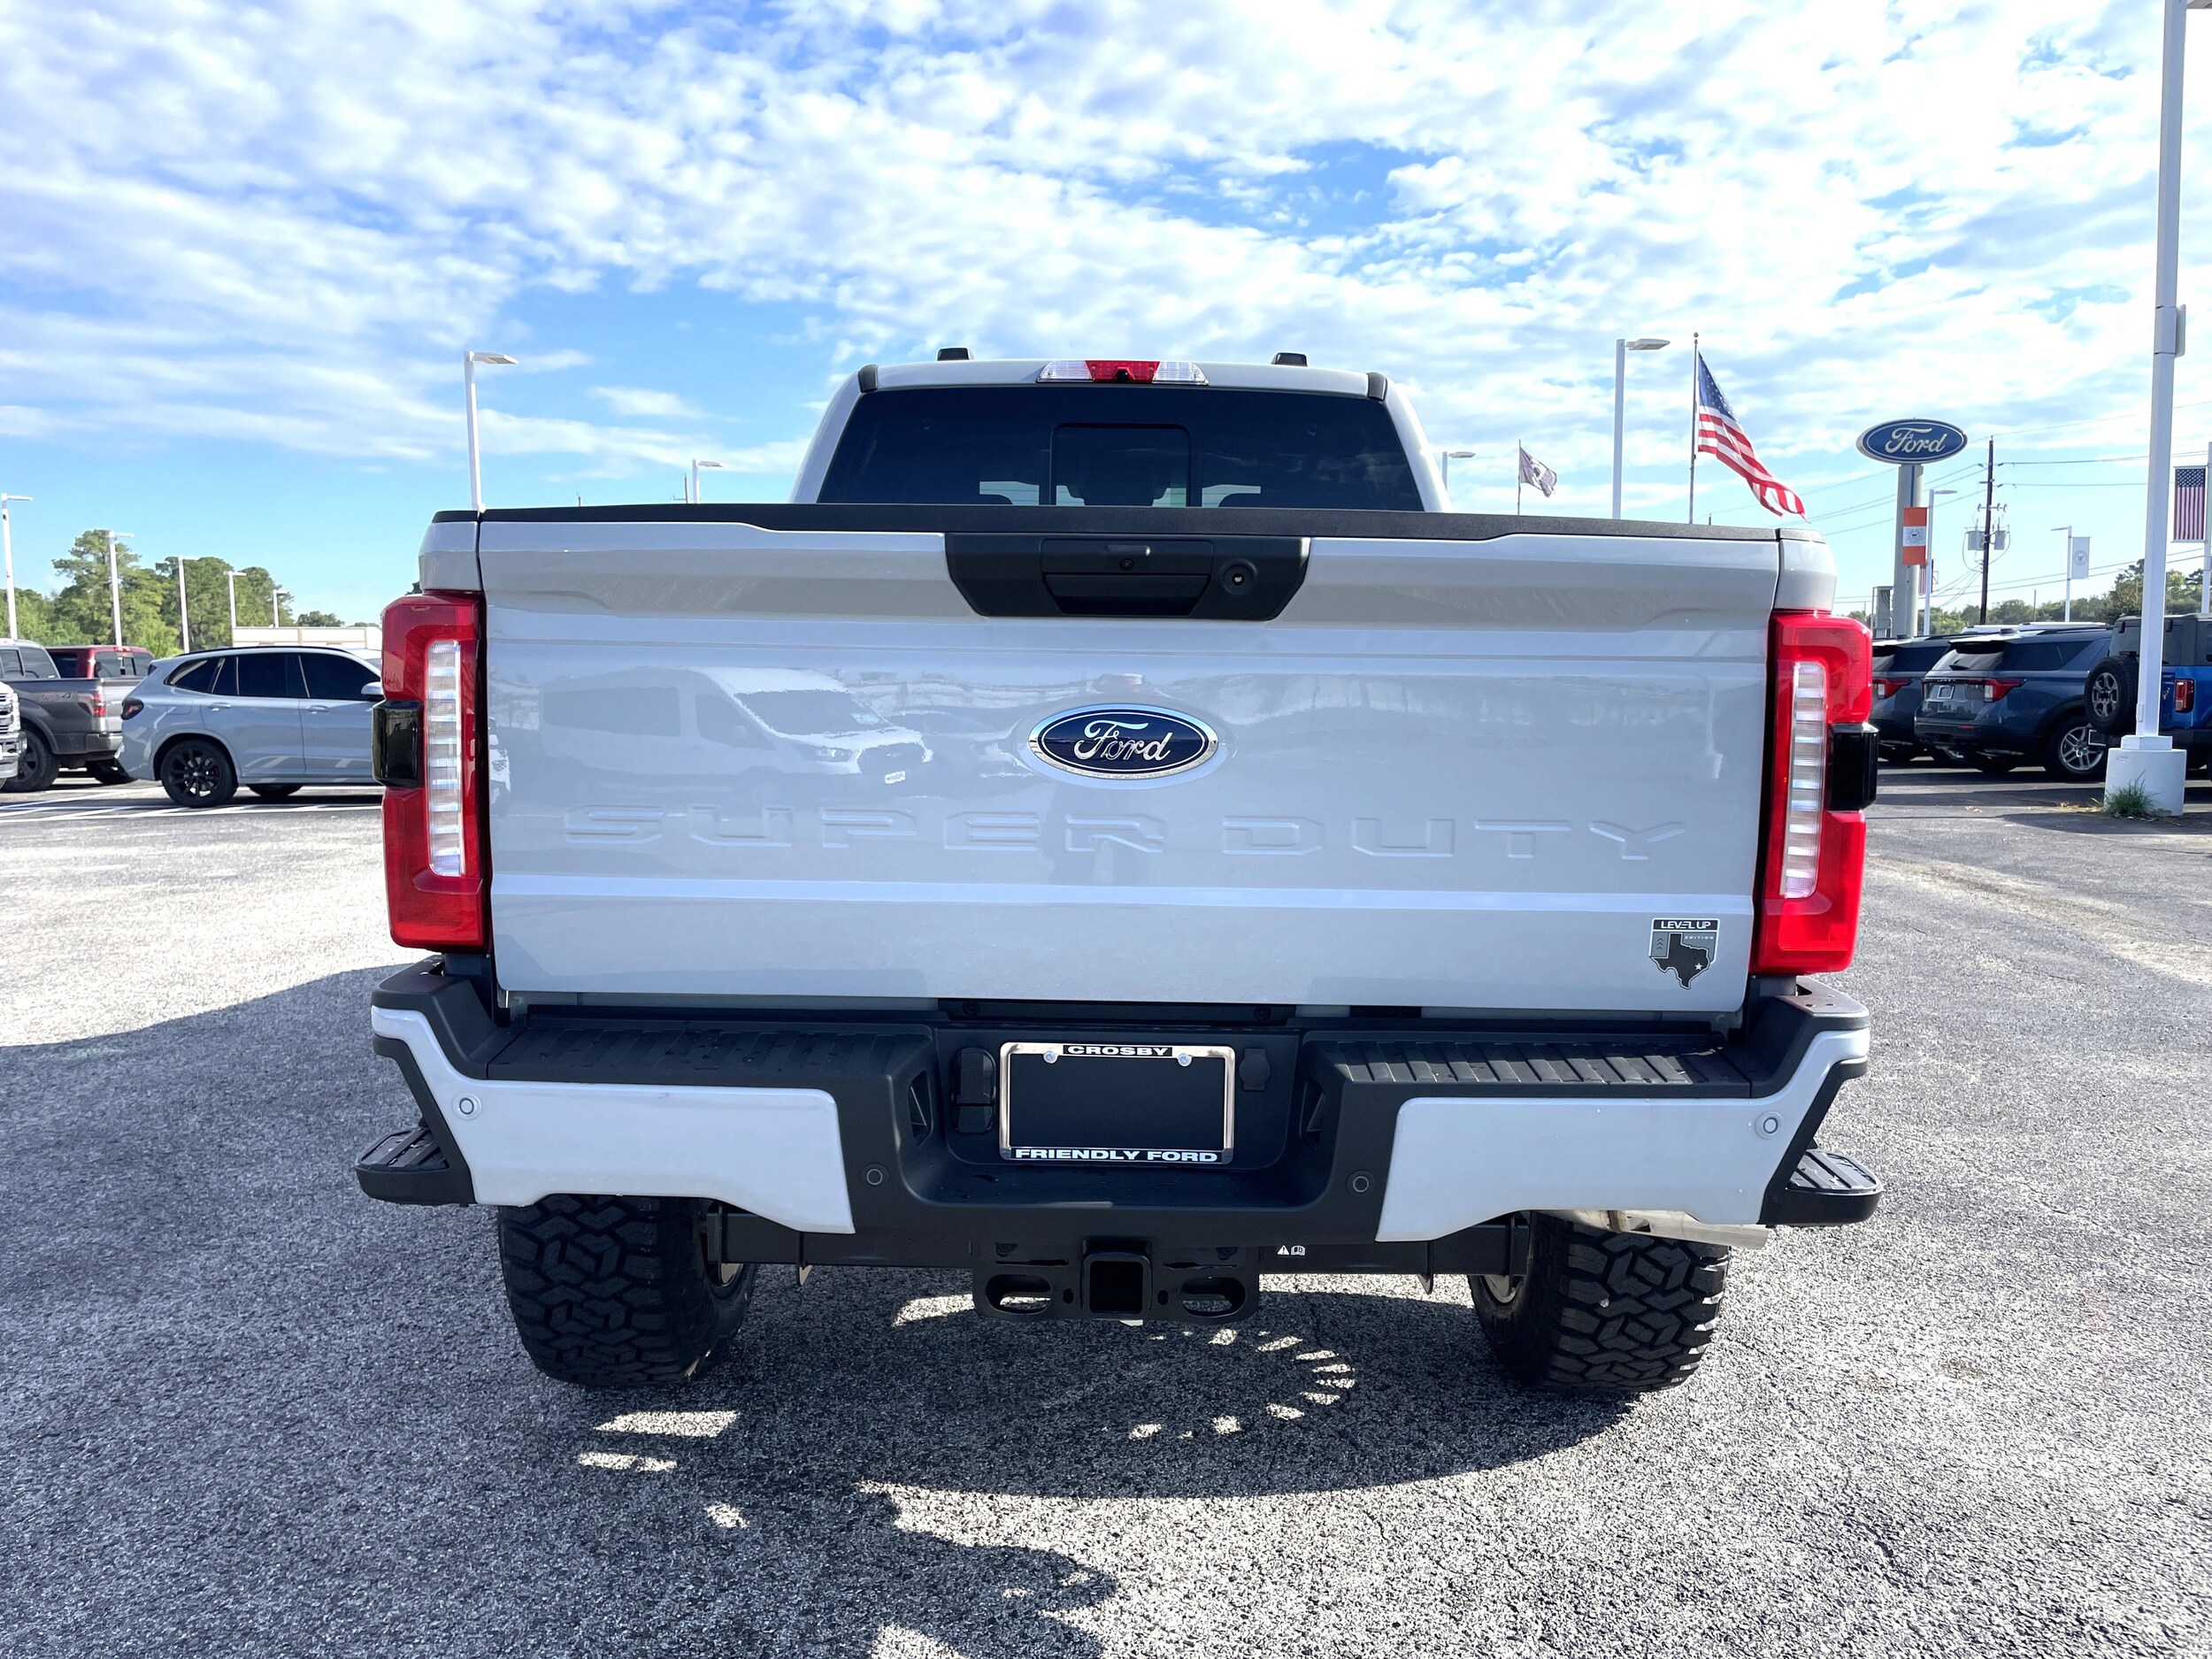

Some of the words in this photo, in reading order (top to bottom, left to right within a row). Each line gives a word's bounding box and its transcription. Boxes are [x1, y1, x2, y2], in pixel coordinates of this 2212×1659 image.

[1885, 427, 1948, 453] Ford
[1073, 719, 1173, 761] Ford
[564, 804, 1166, 852] SUPER
[1223, 816, 1685, 861] DUTY
[1067, 1045, 1168, 1056] CROSBY
[1016, 1148, 1140, 1160] FRIENDLY
[1148, 1151, 1217, 1162] FORD
